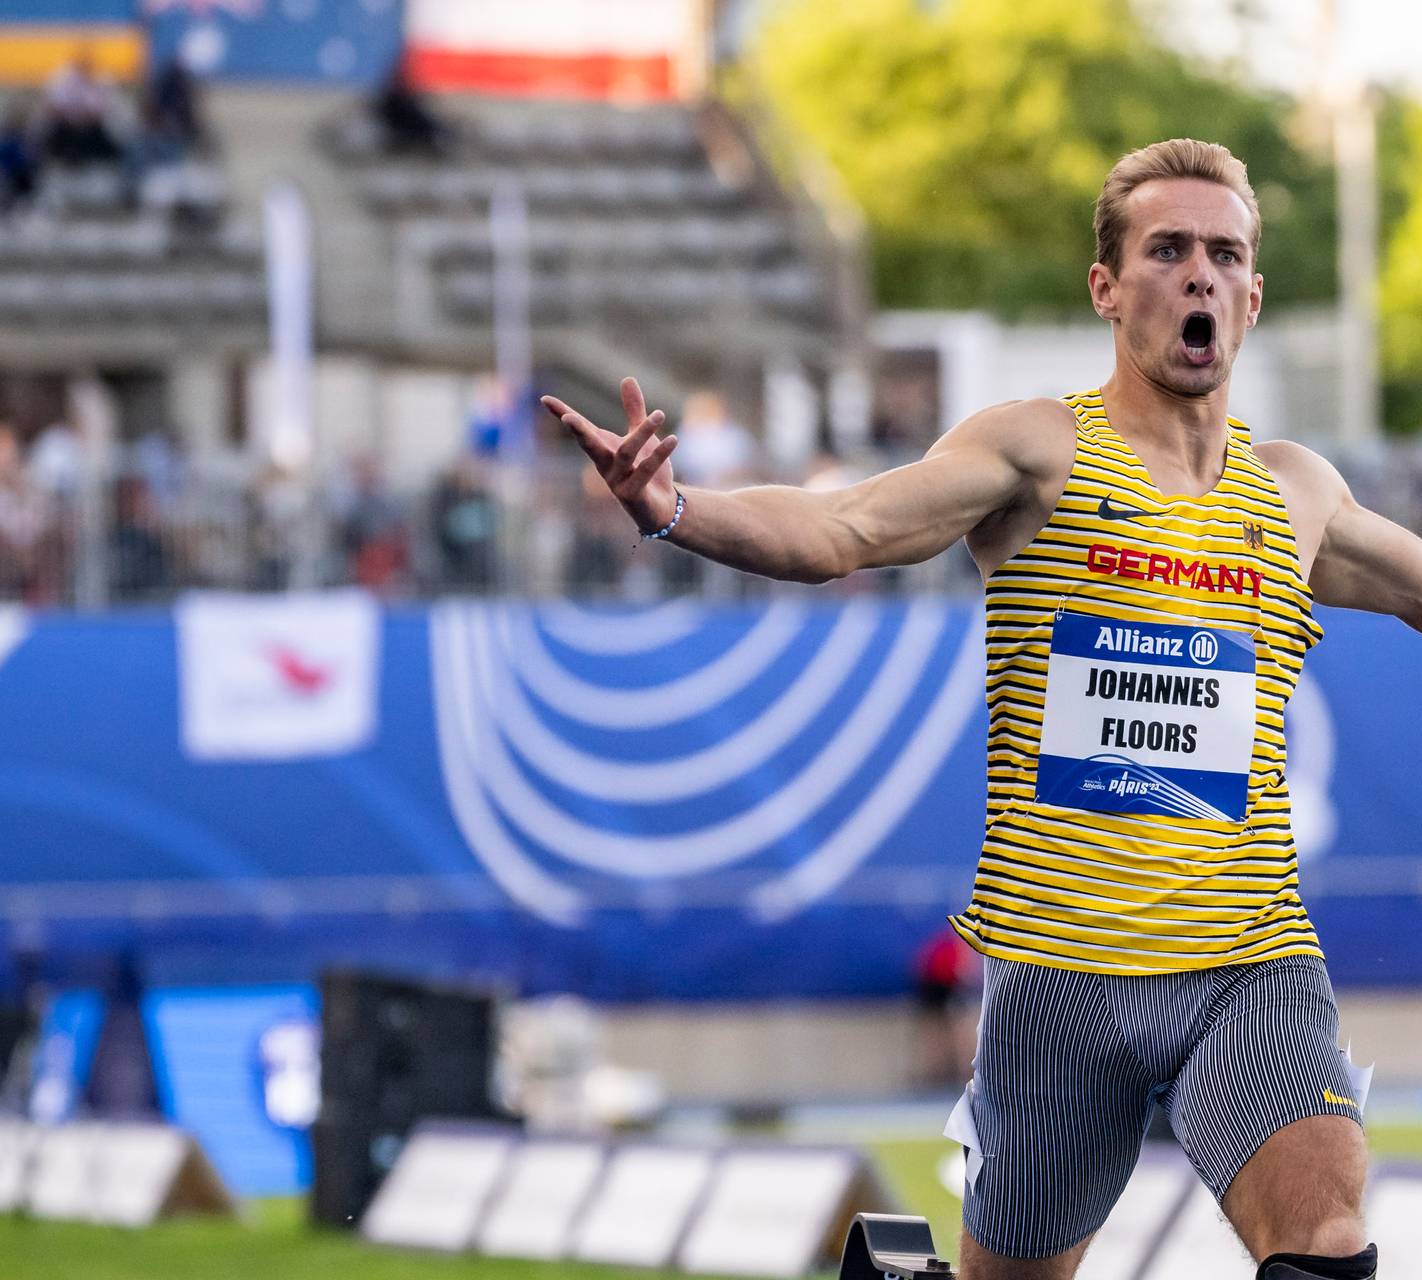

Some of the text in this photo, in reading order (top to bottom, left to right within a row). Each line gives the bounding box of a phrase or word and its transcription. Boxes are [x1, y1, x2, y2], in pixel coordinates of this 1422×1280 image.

[1087, 543, 1265, 598] GERMANY
[1094, 626, 1184, 658] Allianz
[1085, 667, 1220, 709] JOHANNES
[1101, 717, 1198, 753] FLOORS
